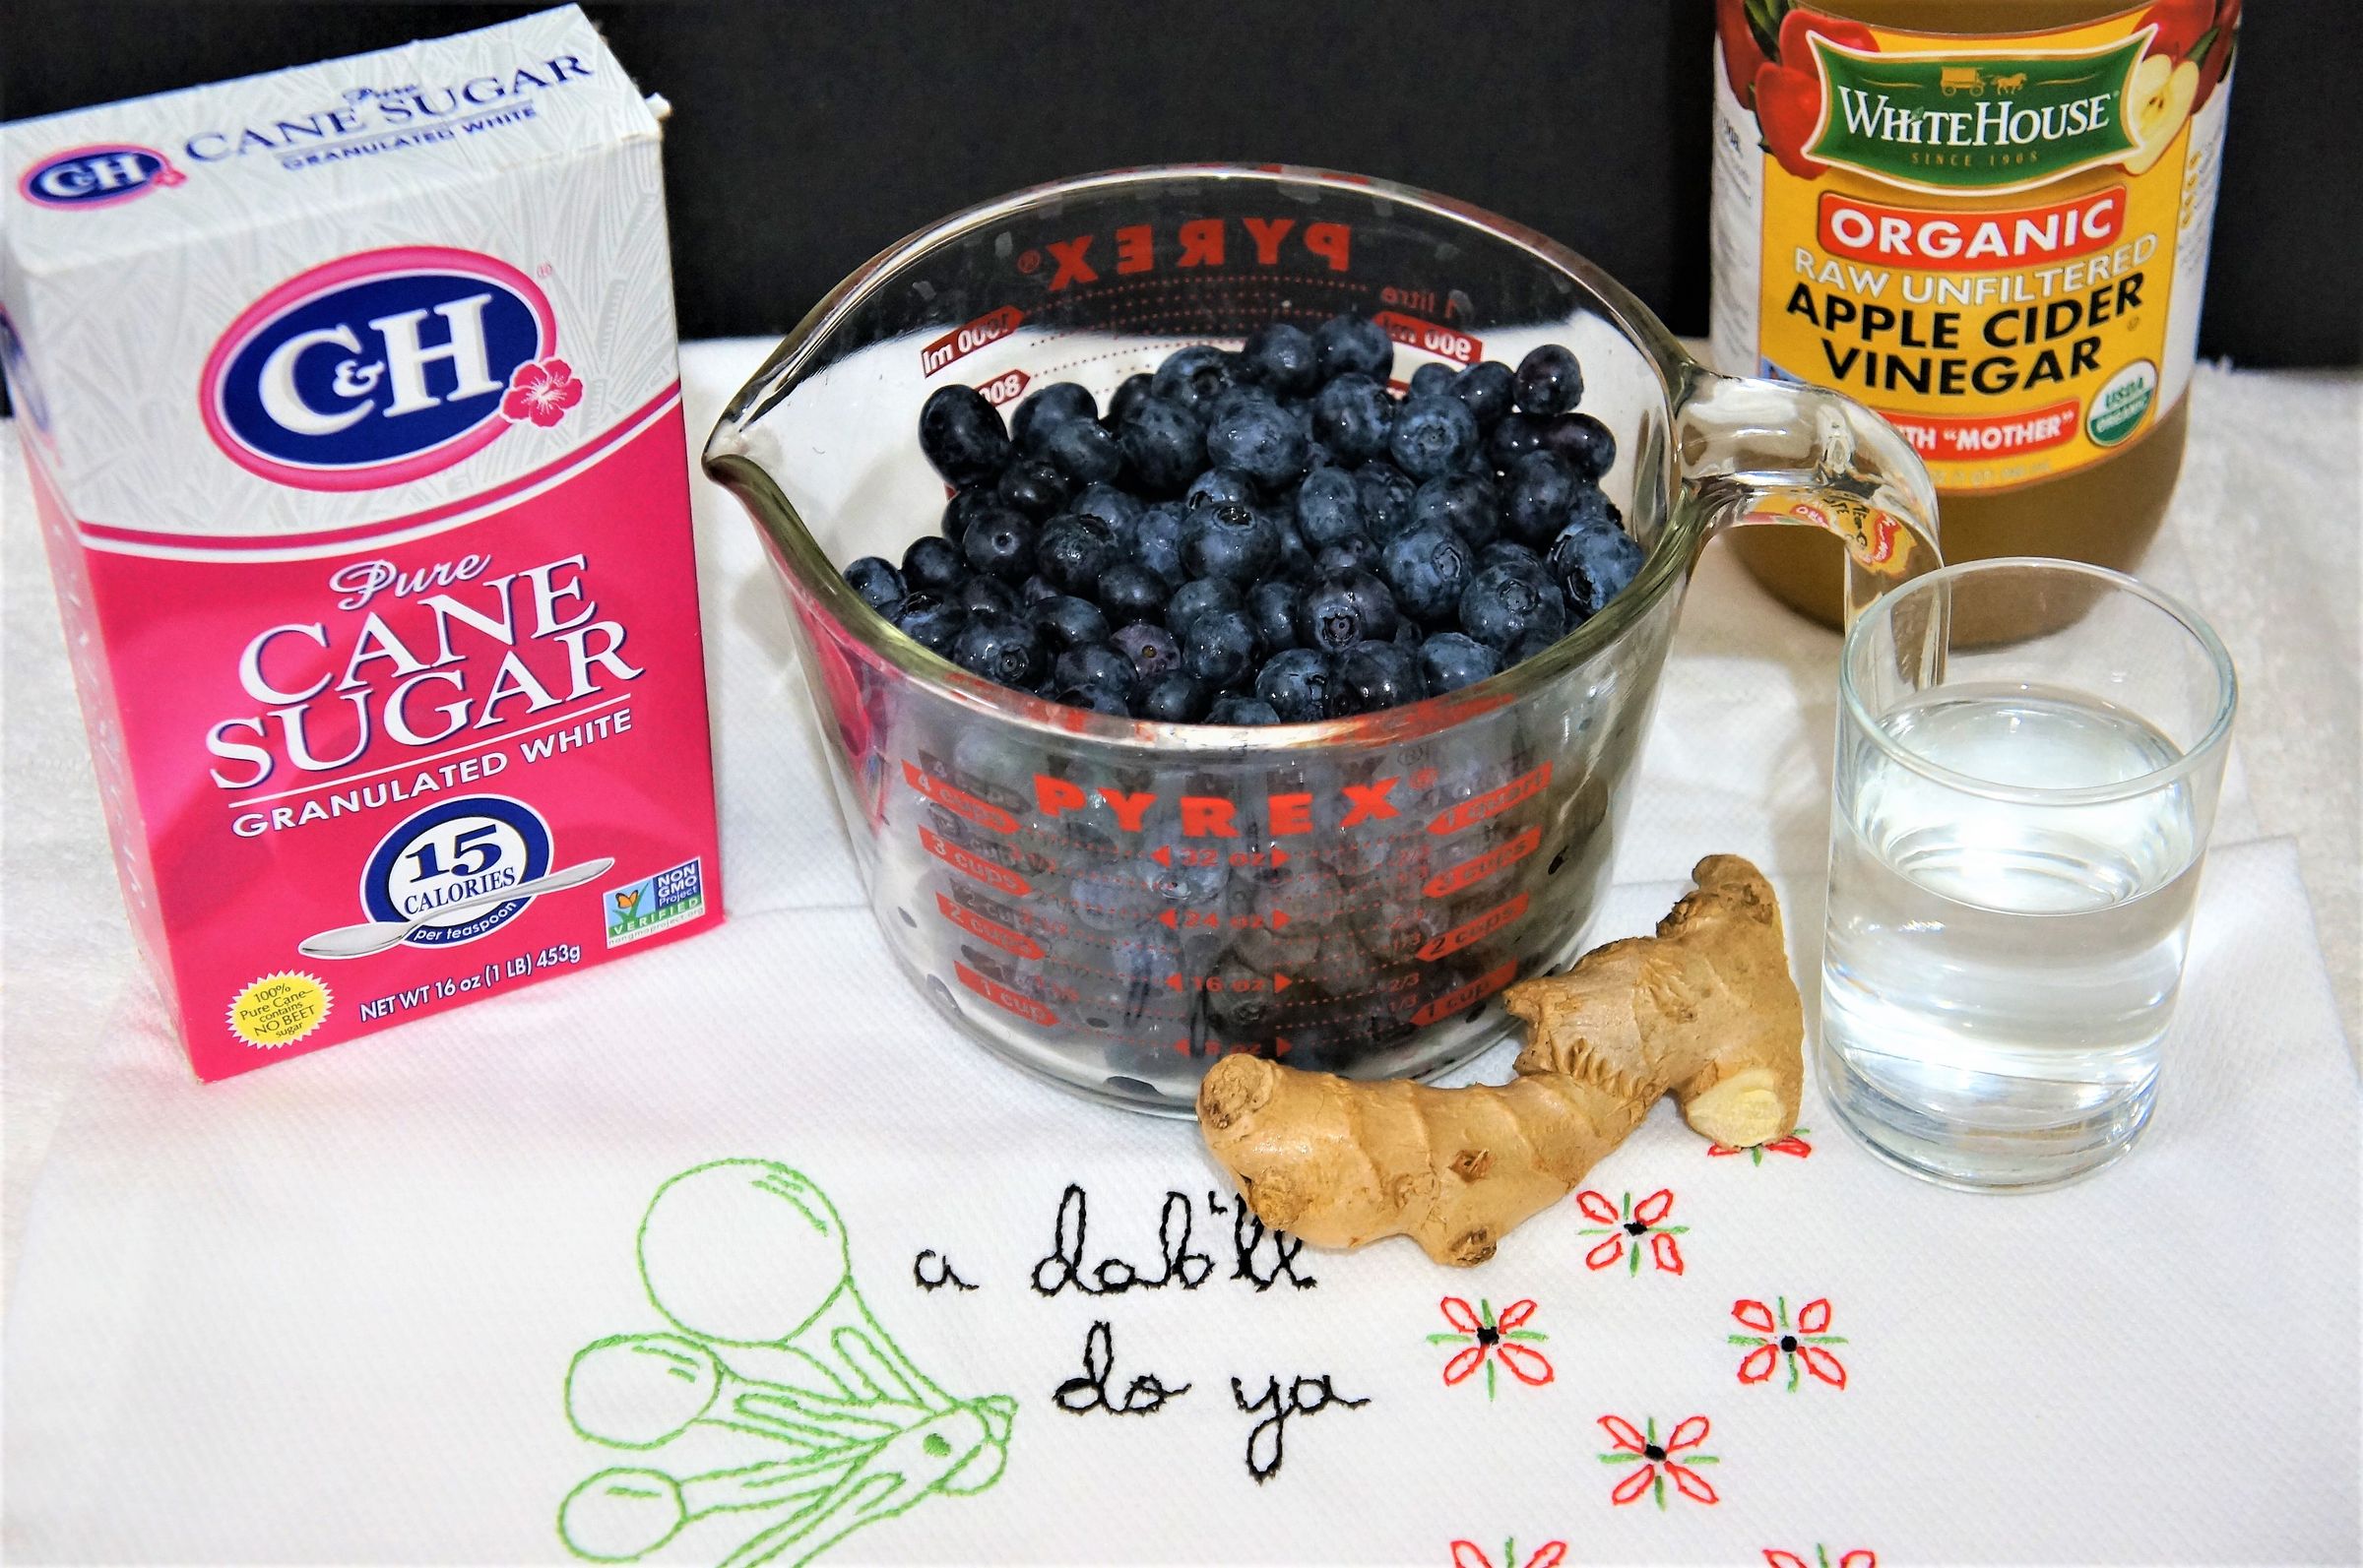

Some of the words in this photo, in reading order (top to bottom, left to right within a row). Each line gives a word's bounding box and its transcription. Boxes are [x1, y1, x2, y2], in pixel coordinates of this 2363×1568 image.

[184, 105, 367, 163] CANE
[380, 55, 594, 123] SUGAR
[281, 128, 456, 170] GRANULATED
[462, 106, 538, 135] WHITE
[1911, 152, 1972, 167] SINCE
[41, 155, 147, 197] C&H
[1830, 198, 2115, 260] ORGANIC
[1794, 246, 1889, 299] RAW
[1901, 233, 2158, 306] UNFILTERED
[1786, 282, 1960, 349] APPLE
[1983, 272, 2144, 348] CIDER
[259, 294, 502, 435] C&H
[1820, 335, 2101, 395] VINEGAR
[1896, 424, 1936, 449] TH
[329, 549, 492, 611] Pure
[238, 554, 597, 707] CANE
[206, 620, 644, 790] SUGAR
[232, 751, 508, 839] GRANULATED
[520, 708, 632, 762] WHITE
[1034, 775, 1400, 838] PYREX
[405, 825, 503, 883] 15
[658, 863, 695, 888] NON
[1182, 848, 1219, 867] 32
[404, 866, 516, 915] CALORIES
[658, 876, 697, 898] GMO
[659, 886, 698, 907] Project
[413, 928, 442, 943] per
[446, 902, 517, 941] teaspoon
[613, 898, 698, 935] VERIFIED
[254, 983, 291, 1003] 100%
[360, 995, 396, 1022] NET
[398, 985, 430, 1009] WT
[435, 978, 456, 1000] 16
[460, 974, 481, 992] oz
[484, 965, 500, 987] (1
[506, 953, 533, 978] LB)
[537, 944, 582, 968] 453g
[239, 1004, 271, 1021] Pure
[254, 1020, 280, 1036] NO
[282, 1004, 315, 1027] BEET
[259, 1001, 303, 1023] contains
[276, 1022, 303, 1038] sugar
[915, 1249, 980, 1292] a
[1052, 1319, 1193, 1415] do
[1231, 1375, 1373, 1485] ya
